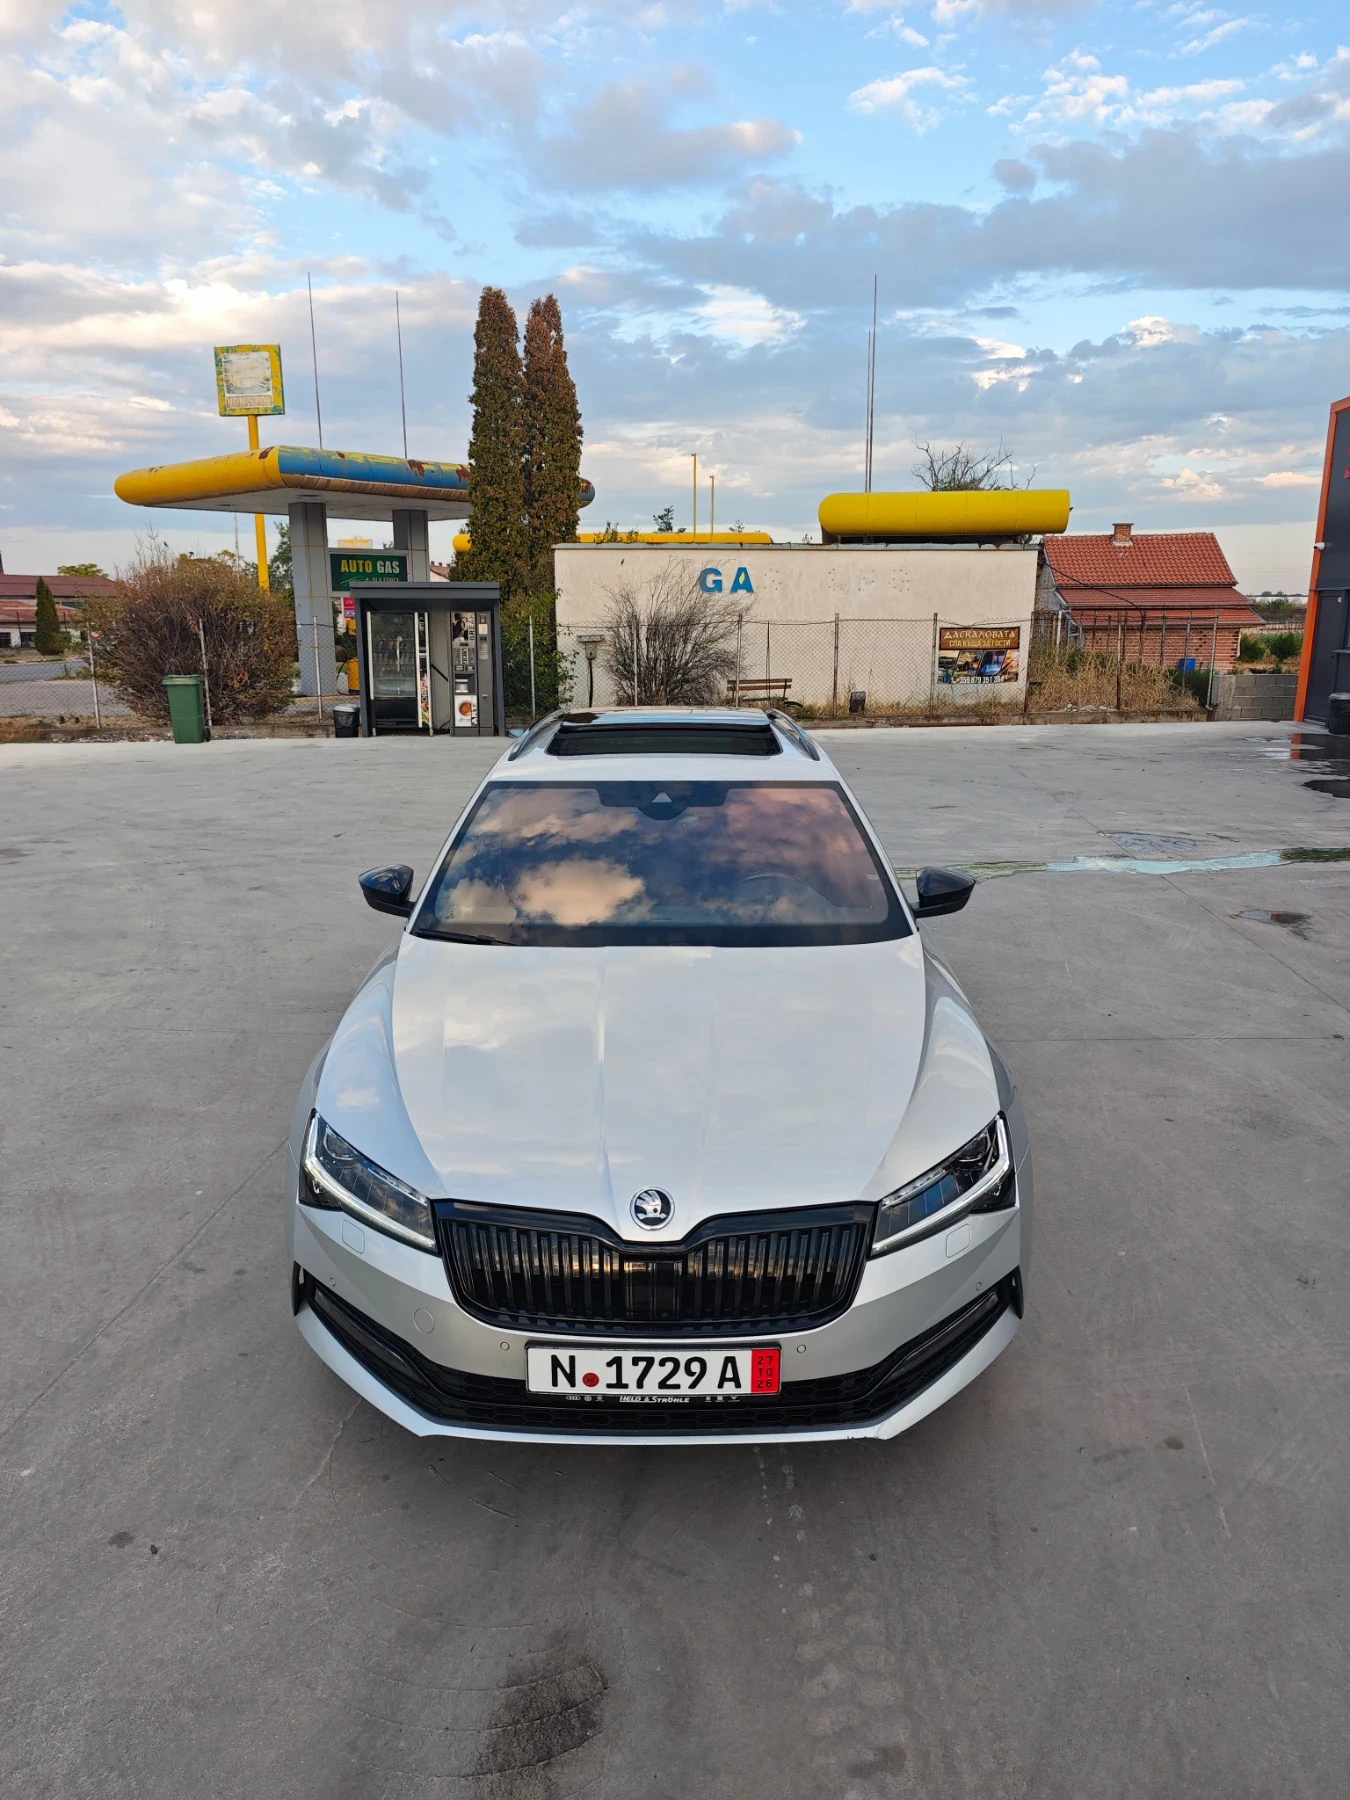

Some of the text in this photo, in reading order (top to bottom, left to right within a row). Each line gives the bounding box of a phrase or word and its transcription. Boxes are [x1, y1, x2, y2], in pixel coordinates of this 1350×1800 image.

[341, 559, 400, 574] AUTO GAS
[944, 630, 1016, 639] ДАСКАЛОВАТА
[992, 639, 1011, 647] ГОСТИ
[757, 1355, 773, 1365] 27
[551, 1354, 742, 1390] N 1729 A
[757, 1367, 773, 1377] 10
[756, 1379, 773, 1389] 26
